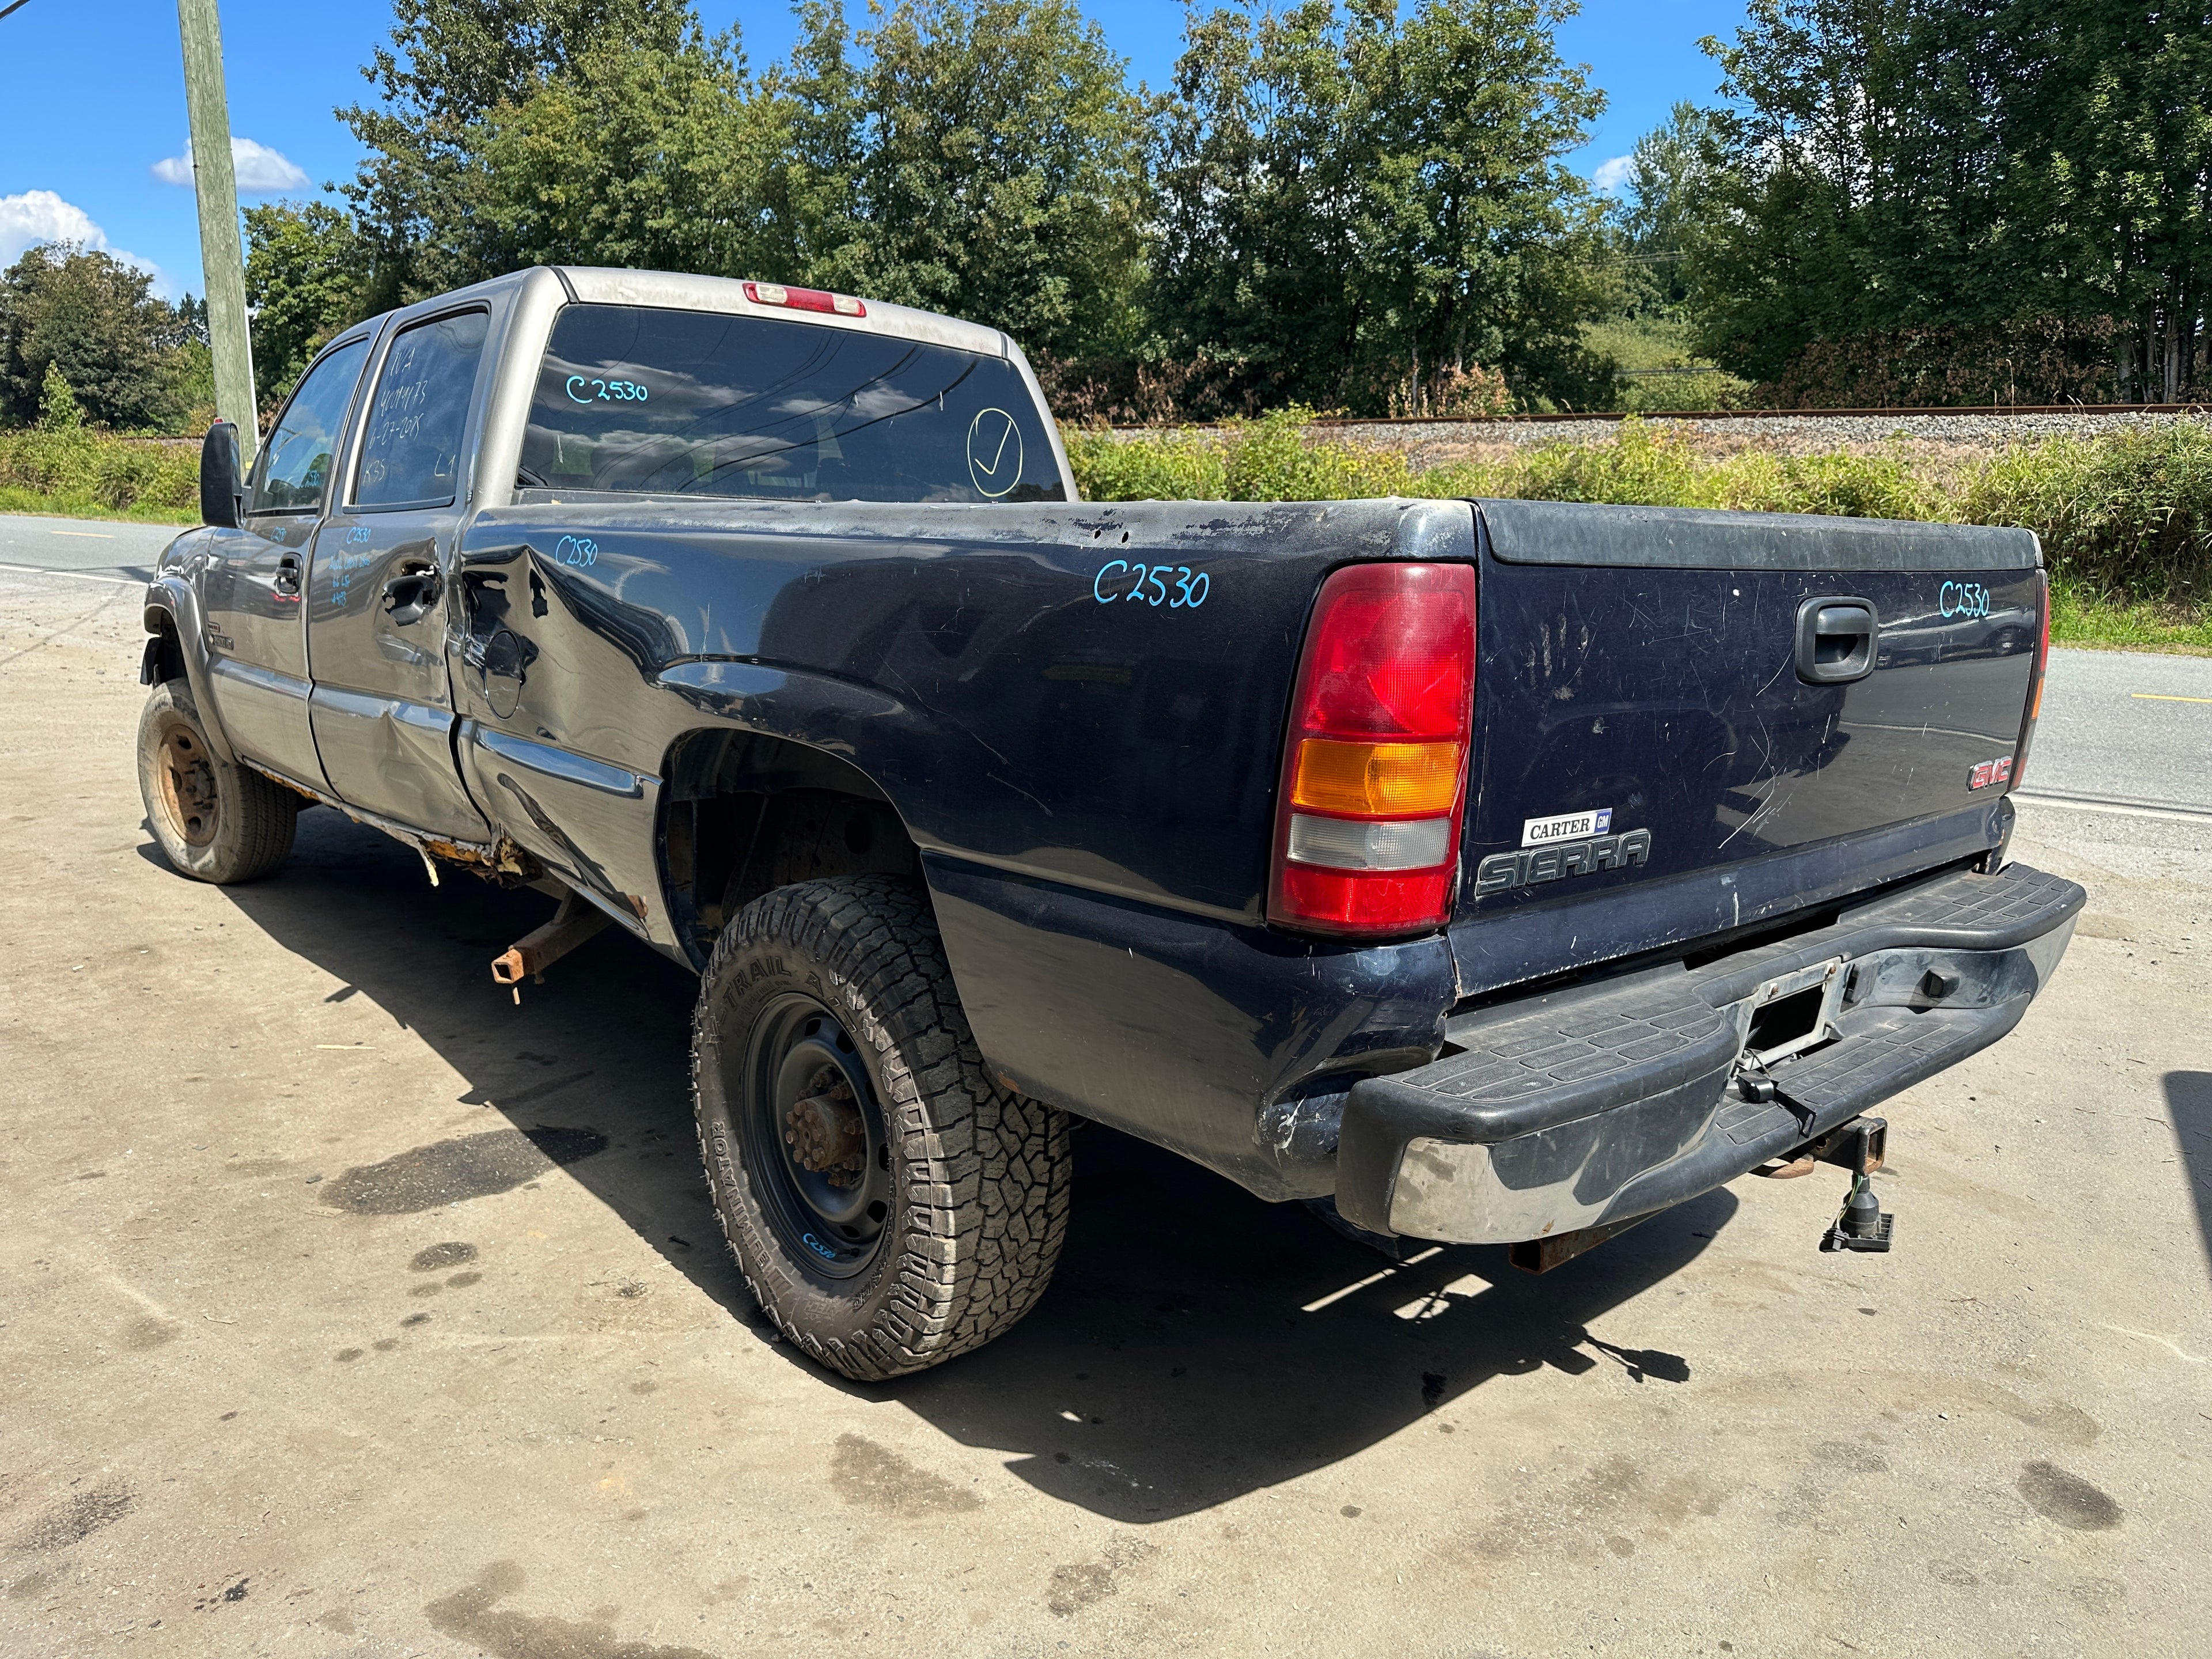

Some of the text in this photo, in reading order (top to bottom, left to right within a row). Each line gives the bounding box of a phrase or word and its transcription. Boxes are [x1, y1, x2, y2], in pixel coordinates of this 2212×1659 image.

[565, 375, 649, 404] C2530
[346, 527, 372, 544] C2530
[555, 536, 599, 567] C2530
[1094, 559, 1210, 608] C2530
[1939, 580, 1990, 619] C2530
[1967, 756, 2012, 792] GMC
[1529, 813, 1610, 840] CARTER GM
[1476, 828, 1652, 897] SIERRA
[711, 1121, 772, 1274] ELIMINATOR
[802, 1233, 836, 1259] C2530
